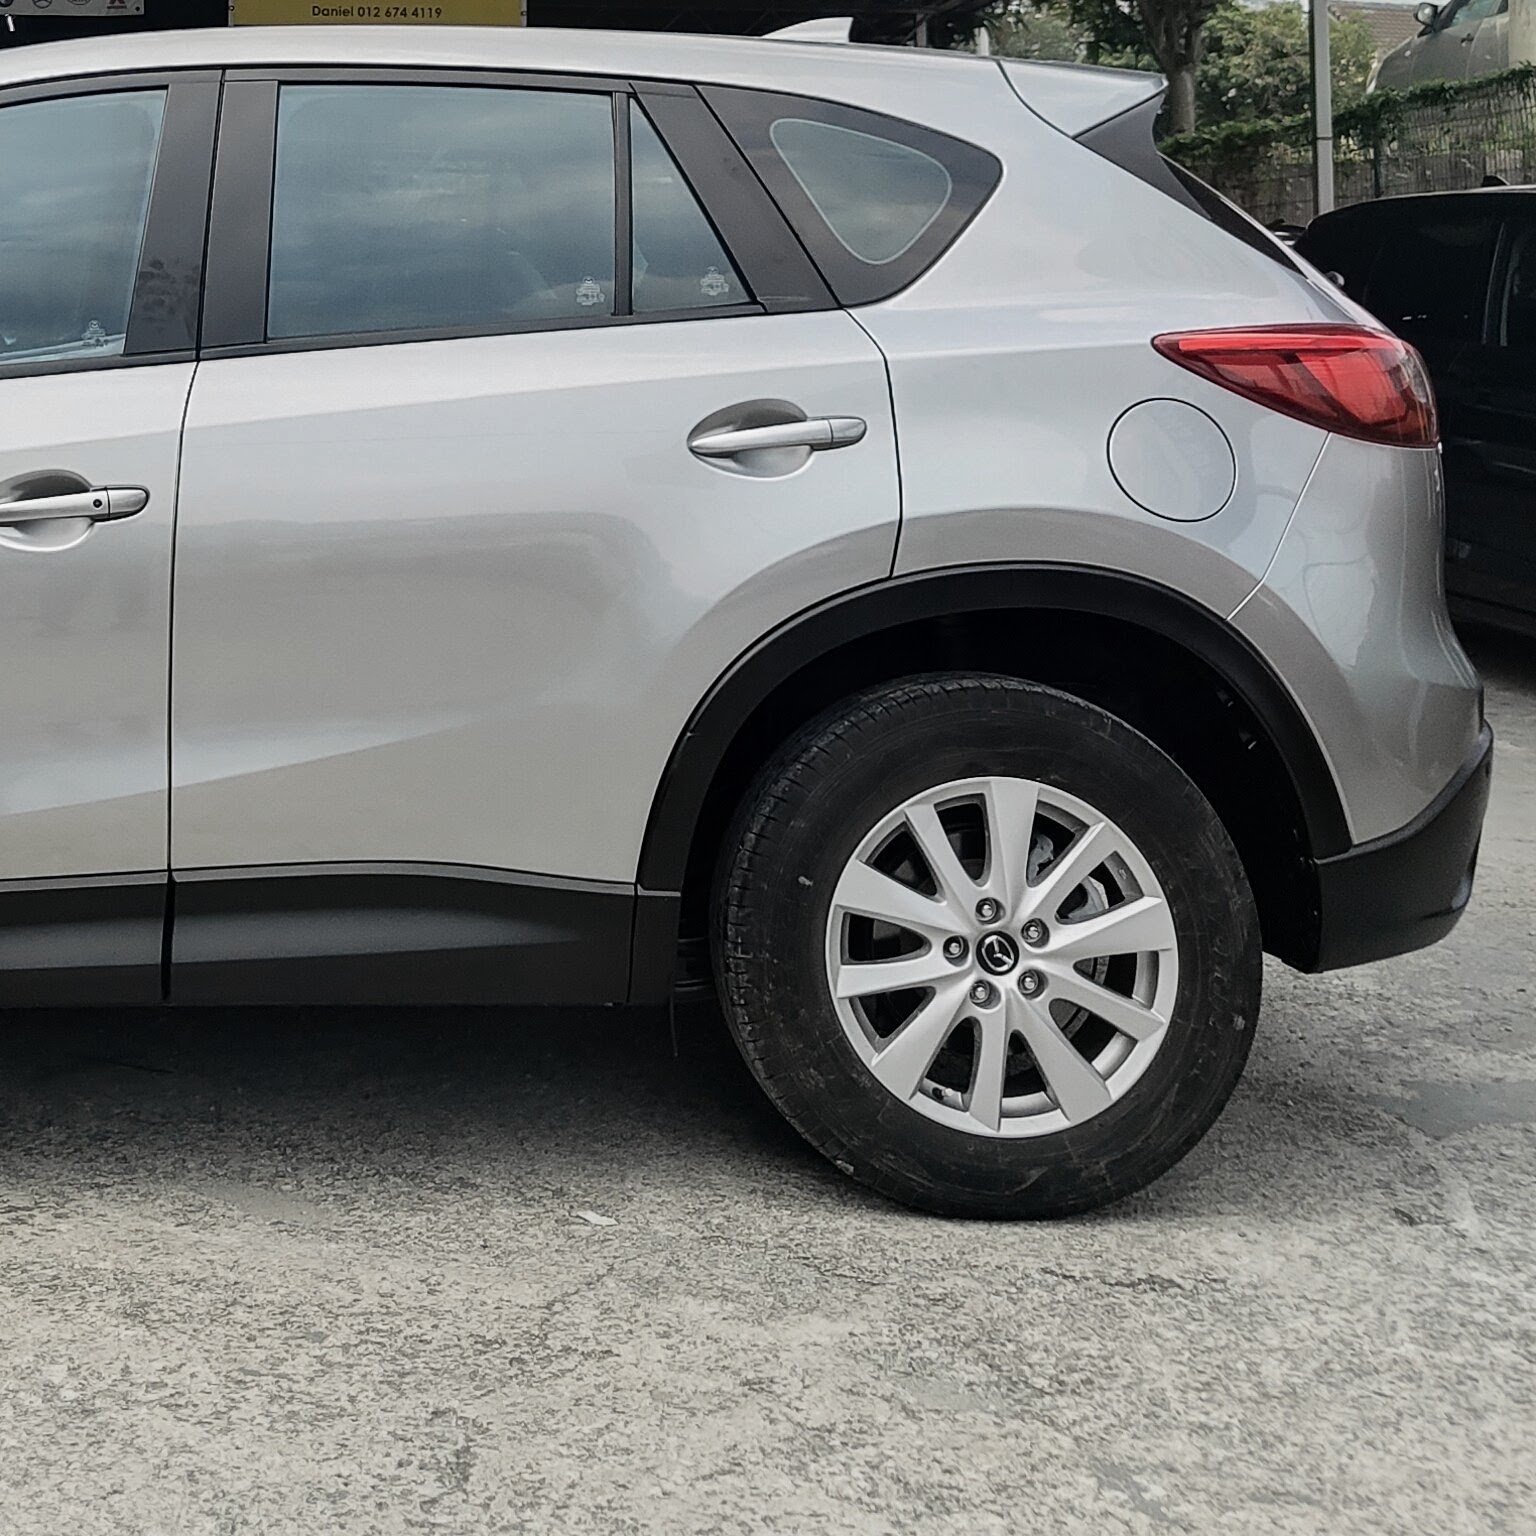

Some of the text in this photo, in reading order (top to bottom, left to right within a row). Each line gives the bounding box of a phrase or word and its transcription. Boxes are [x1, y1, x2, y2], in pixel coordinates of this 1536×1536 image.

[312, 5, 442, 19] Daniel 012 674 4119
